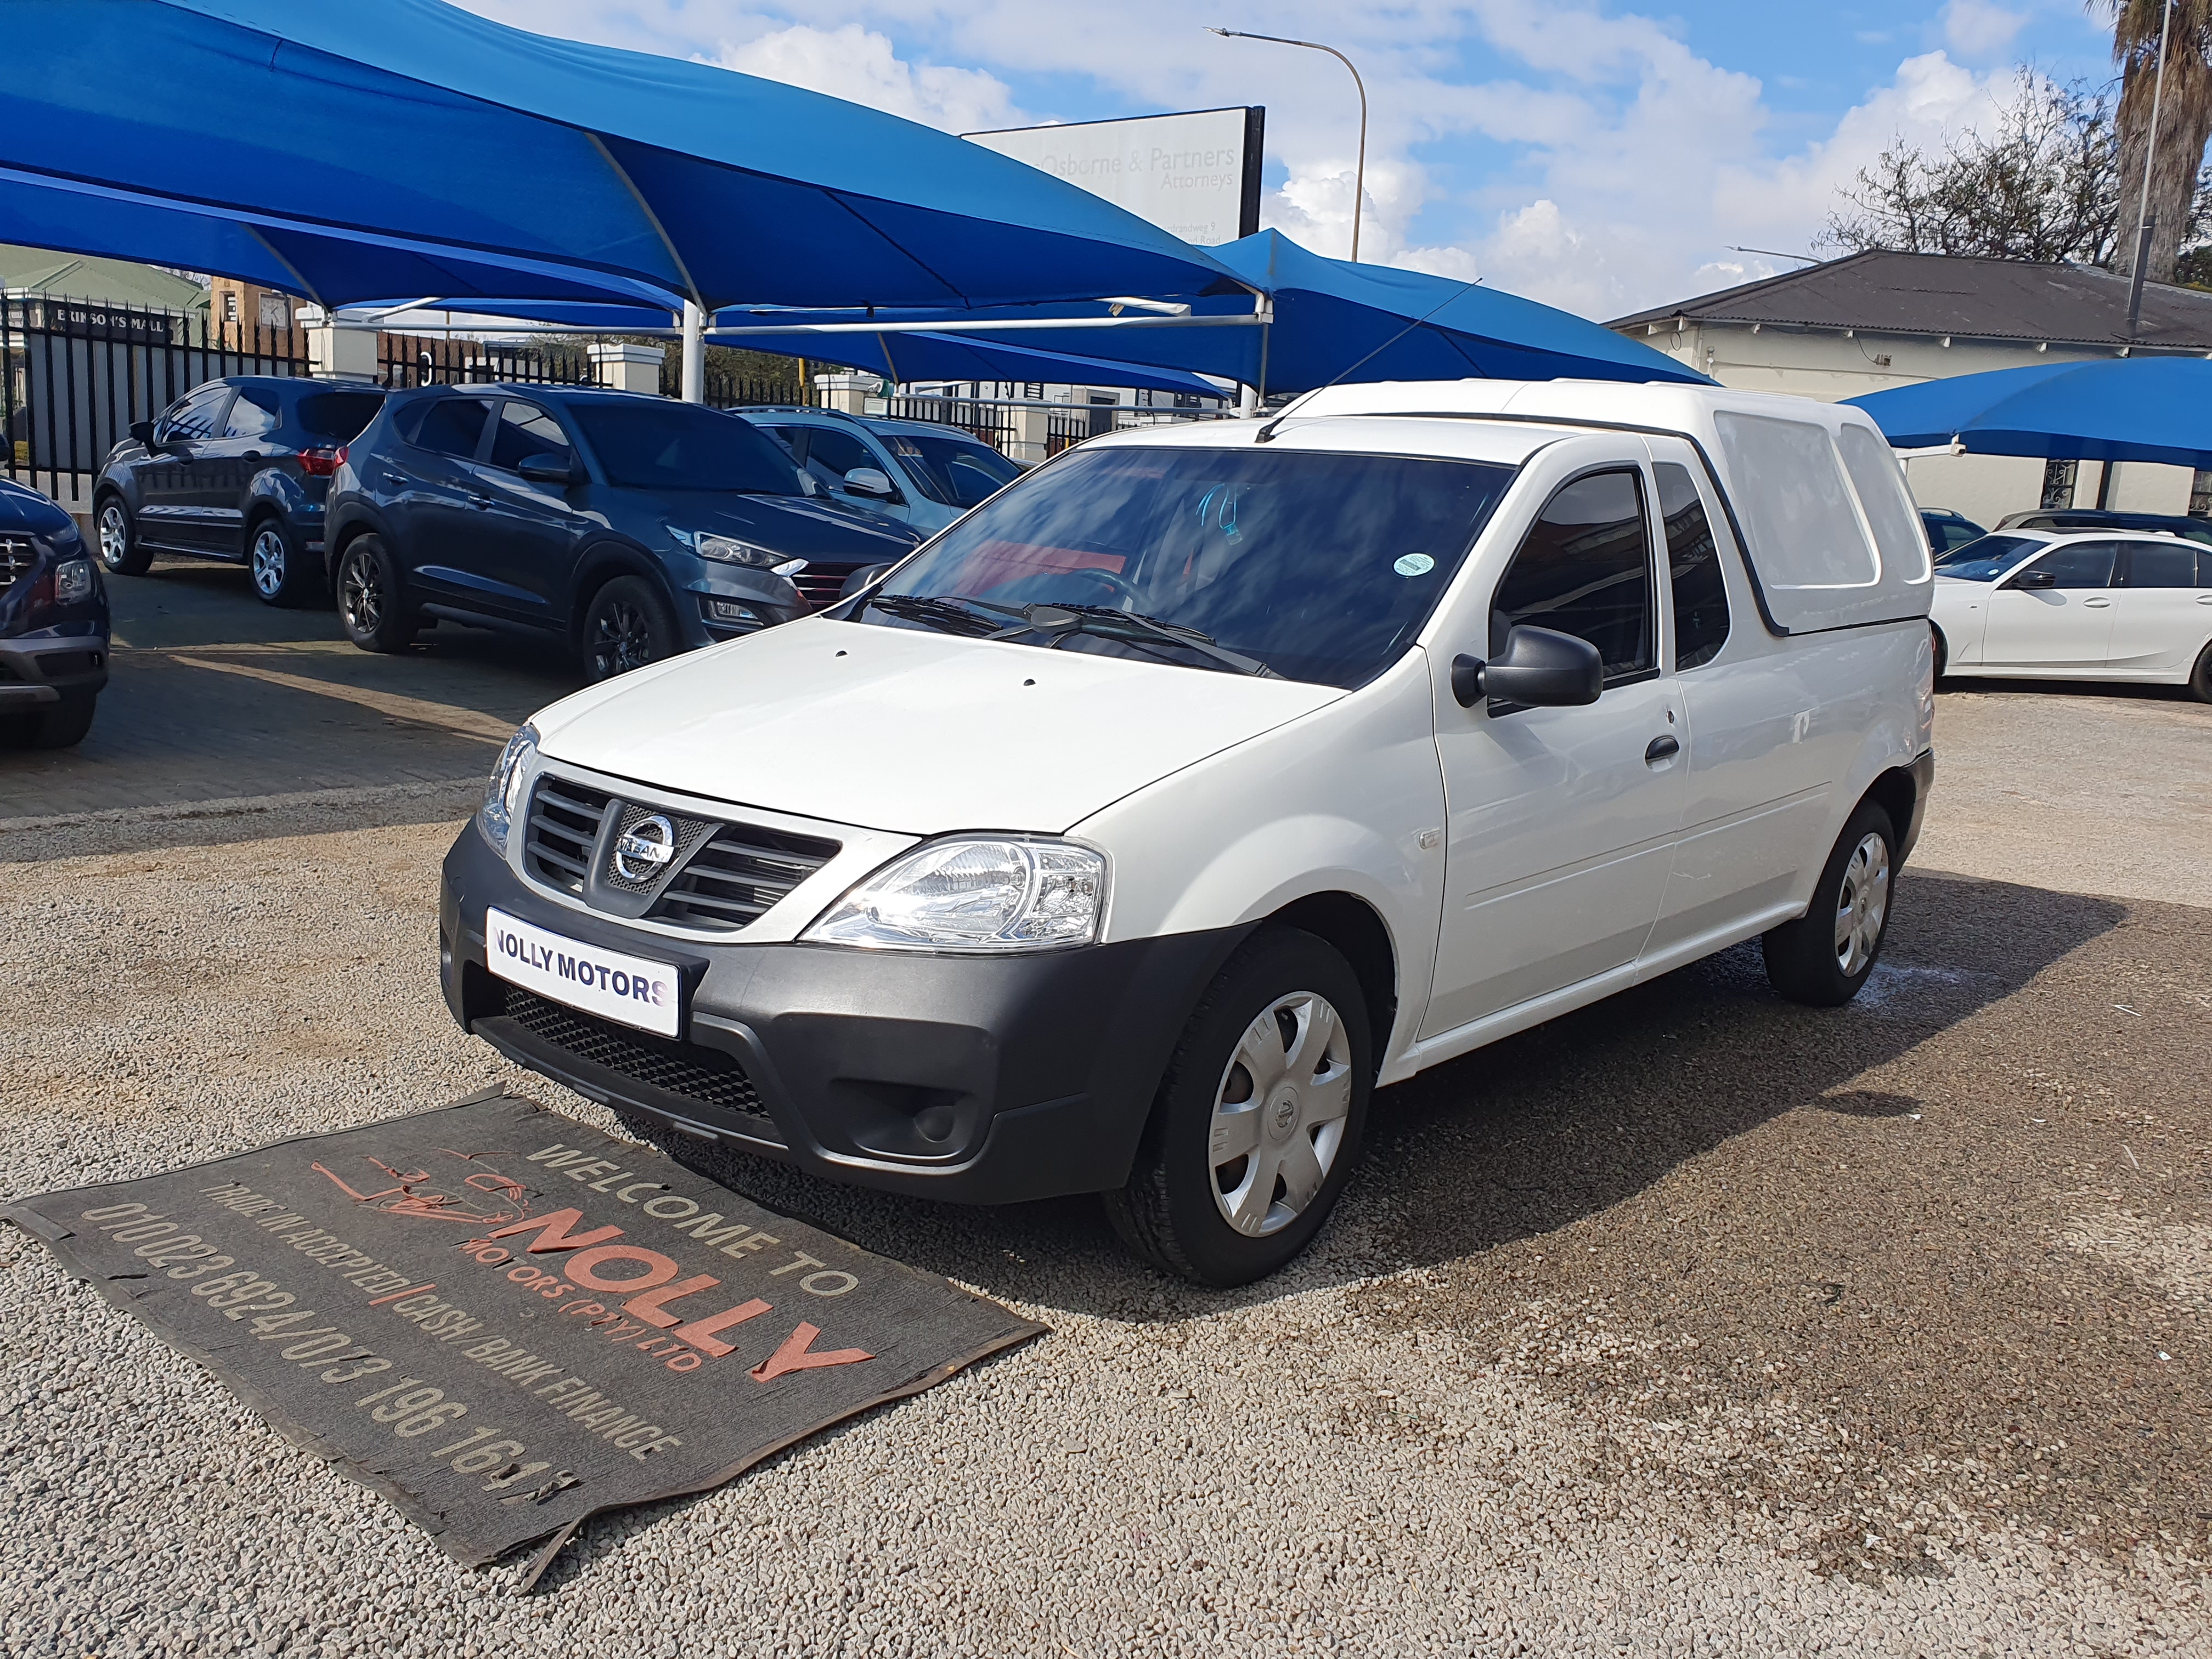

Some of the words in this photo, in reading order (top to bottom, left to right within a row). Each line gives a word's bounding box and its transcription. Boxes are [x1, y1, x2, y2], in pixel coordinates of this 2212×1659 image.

[1128, 150, 1143, 172] &
[1150, 148, 1235, 171] Partners
[1160, 173, 1233, 191] Attorneys
[1200, 235, 1221, 245] Road
[1211, 222, 1216, 231] 9
[131, 318, 164, 332] MALL
[494, 926, 554, 972] NOLLY
[557, 952, 668, 1007] MOTORS
[199, 1181, 288, 1218] TRADE
[256, 1212, 311, 1233] IN
[526, 1143, 781, 1259] WELCOME
[769, 1250, 859, 1296] TO
[278, 1228, 411, 1294] ACCEPTED
[458, 1238, 575, 1299] MOTORS
[557, 1299, 647, 1342] (PTY)
[635, 1336, 703, 1372] LTD
[487, 1207, 876, 1384] NOLLY
[355, 1373, 469, 1438] 196
[533, 1376, 684, 1463] FINANCE
